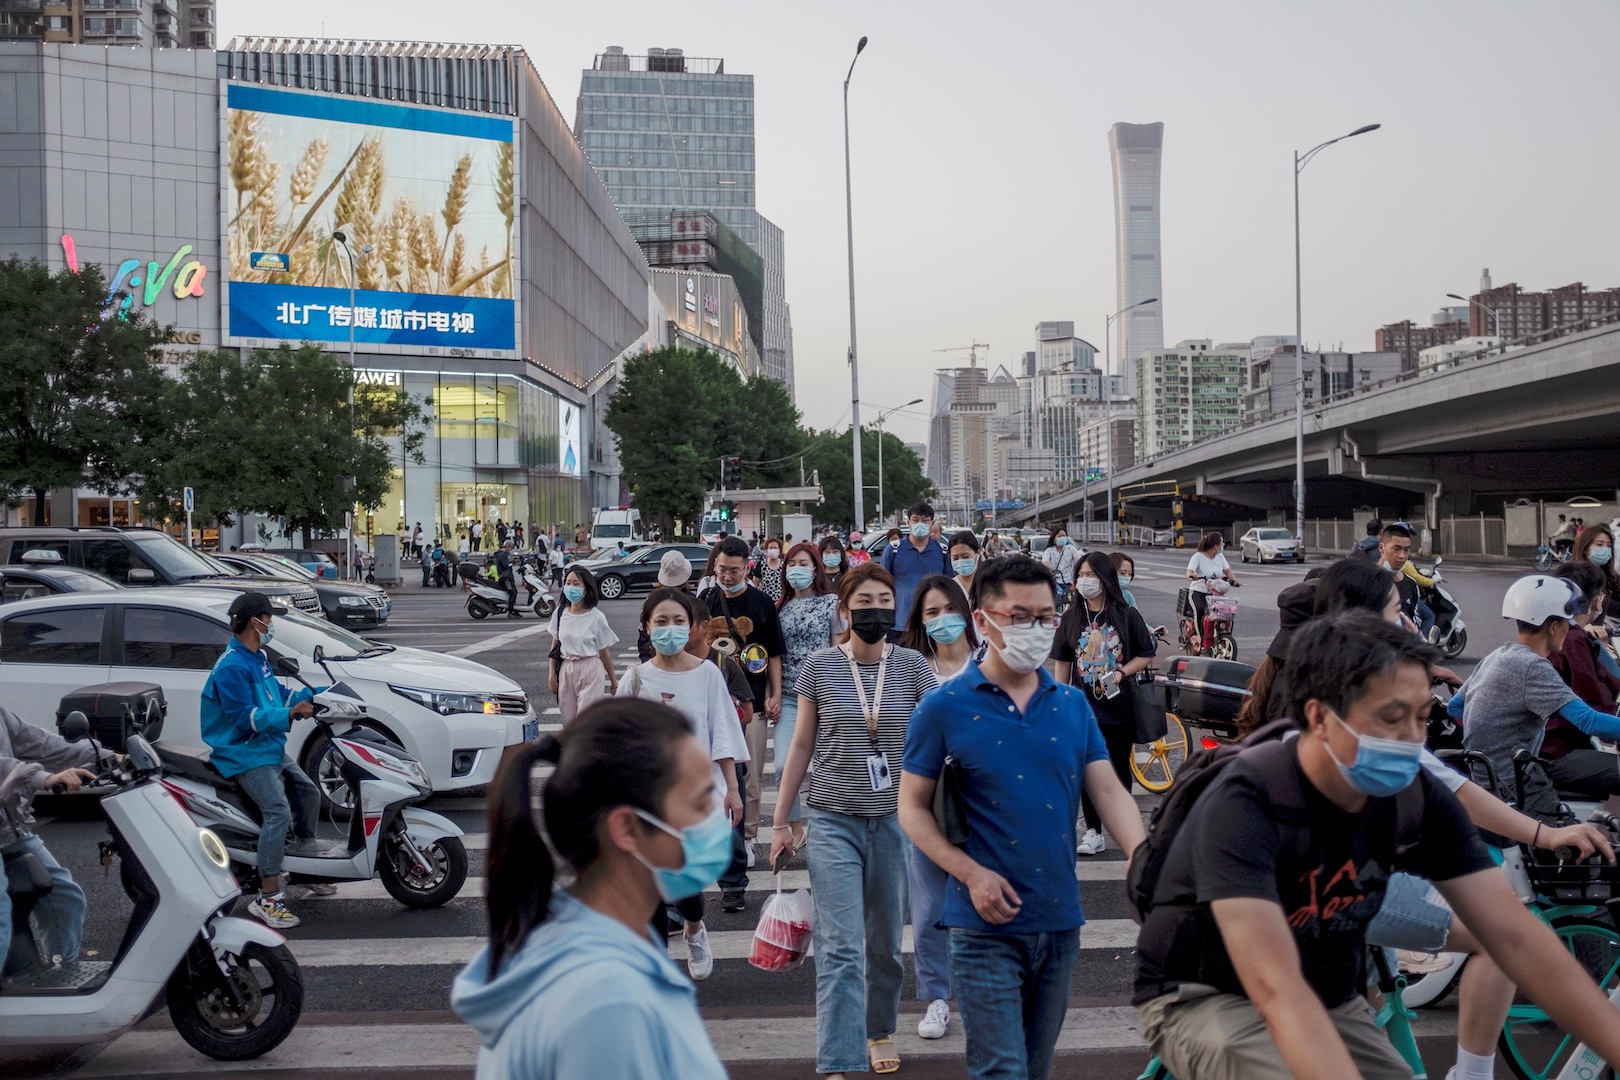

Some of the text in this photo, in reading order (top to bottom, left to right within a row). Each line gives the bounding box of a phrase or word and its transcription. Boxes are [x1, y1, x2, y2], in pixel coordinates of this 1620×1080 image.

[276, 302, 475, 333] 北广传媒城市电视
